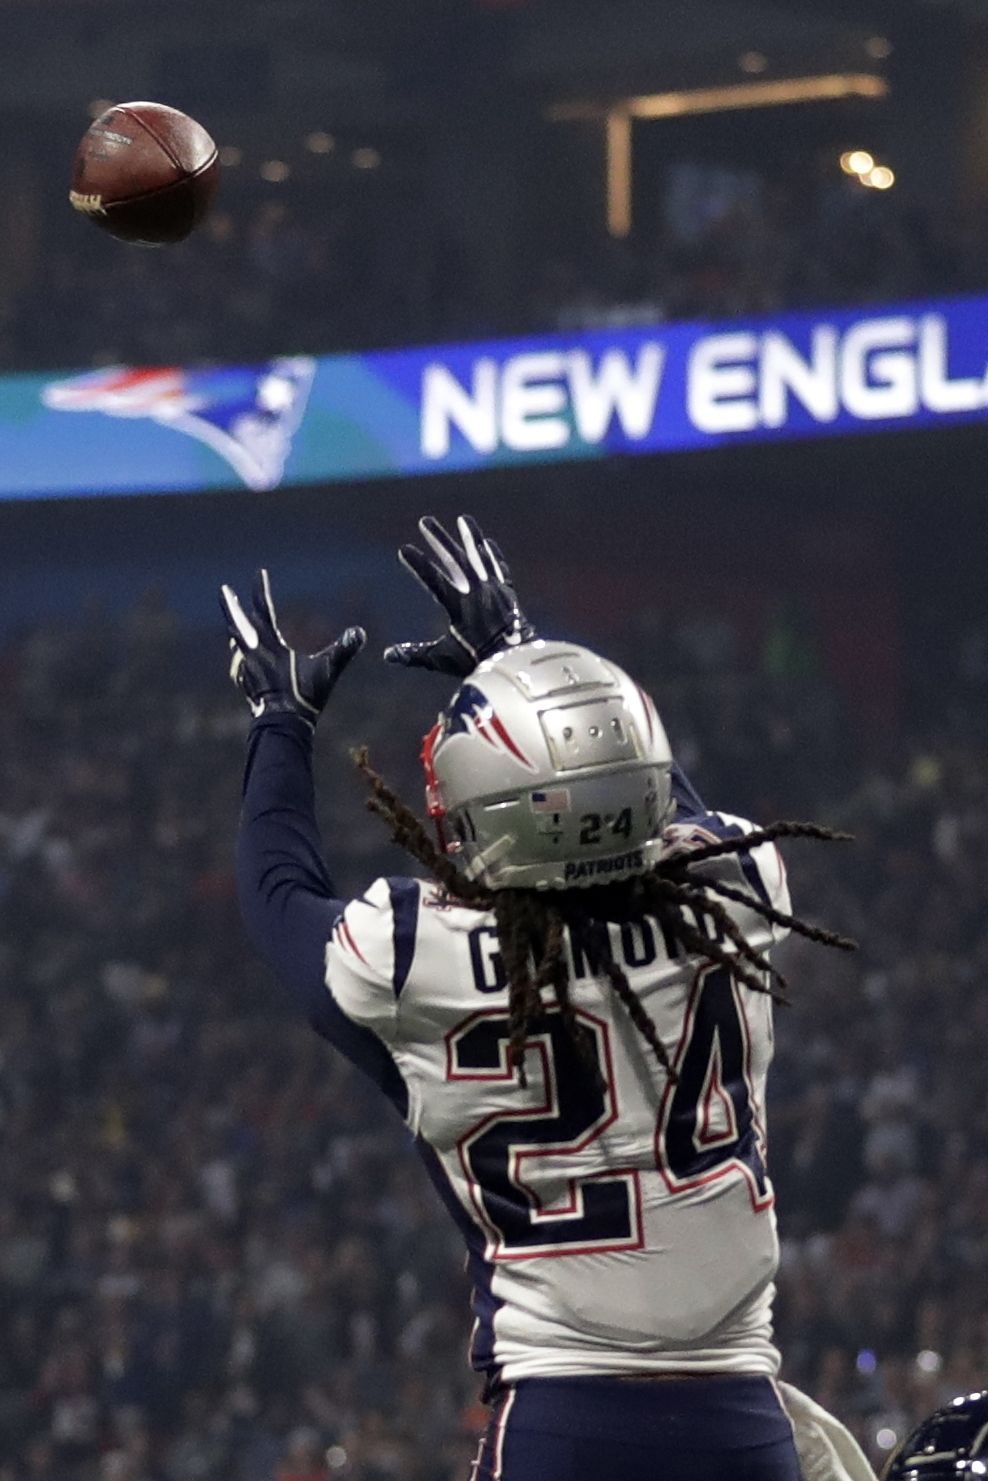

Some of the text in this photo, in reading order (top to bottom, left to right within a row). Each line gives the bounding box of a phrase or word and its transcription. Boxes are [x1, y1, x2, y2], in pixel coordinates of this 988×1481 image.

[421, 342, 665, 459] NEW
[564, 850, 643, 880] PATRIOTS
[579, 806, 633, 846] 24
[445, 957, 774, 1260] 24
